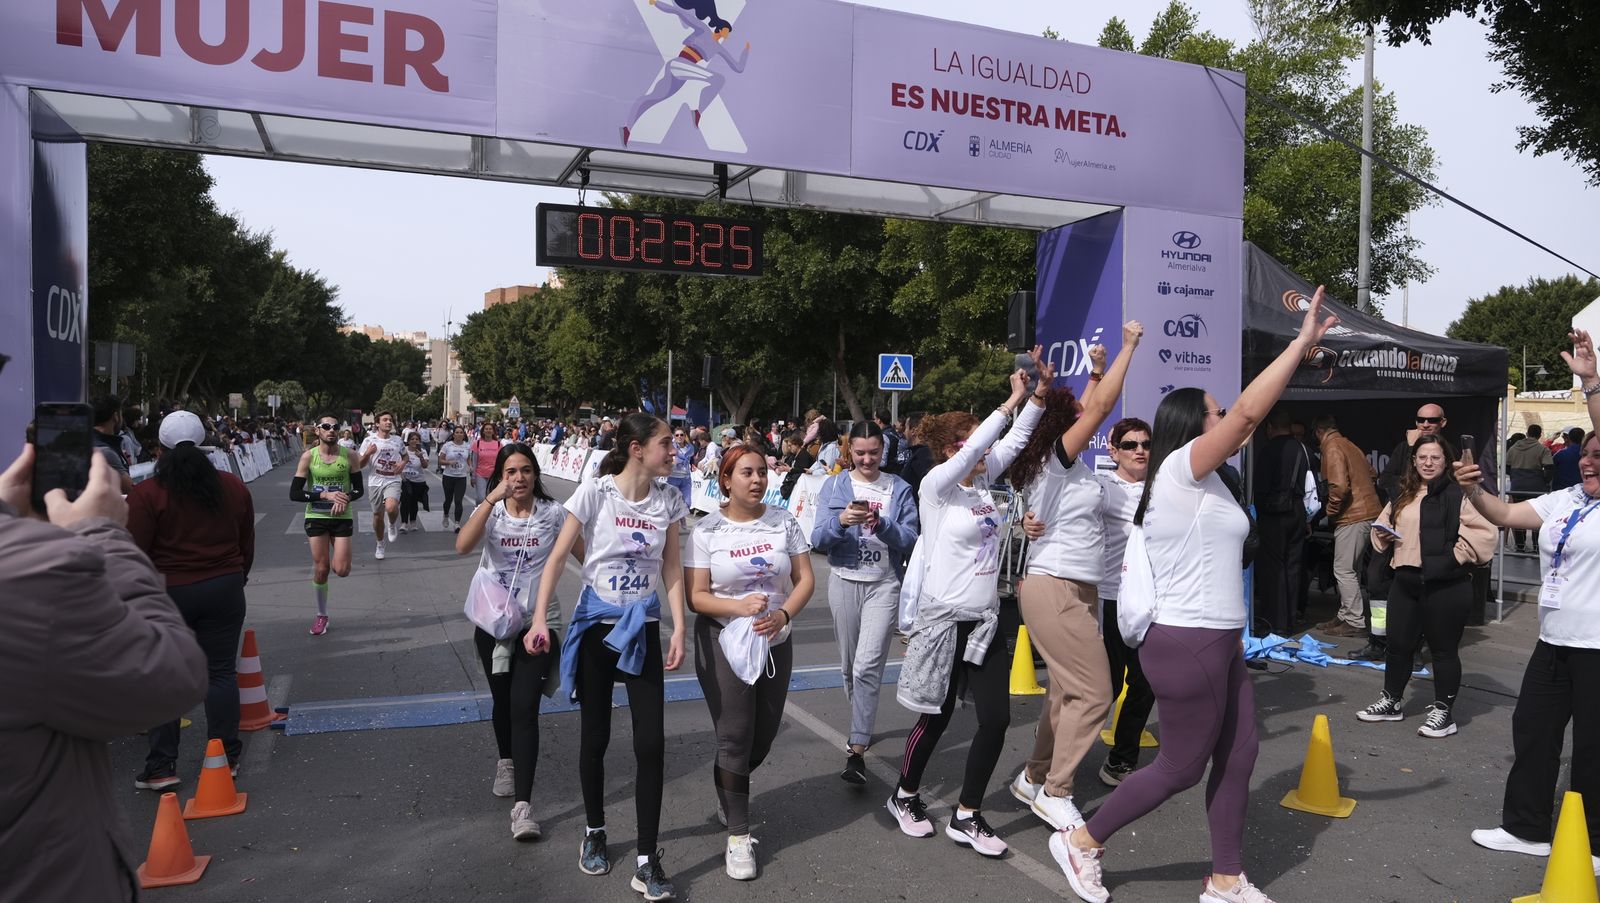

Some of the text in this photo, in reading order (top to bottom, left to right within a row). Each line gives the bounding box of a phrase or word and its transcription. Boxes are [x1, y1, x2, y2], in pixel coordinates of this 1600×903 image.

[56, 0, 450, 92] MUJER
[933, 47, 1092, 95] LA IGUALDAD
[891, 82, 1127, 138] ES NUESTRA META.
[903, 130, 945, 153] CDX
[989, 139, 1033, 155] ALMERÍA
[988, 151, 1012, 159] CIUDAD
[578, 213, 753, 270] 00:23:25
[1161, 250, 1212, 263] HYUNDAI
[1174, 284, 1215, 298] cajamar
[46, 285, 82, 344] CDX
[1163, 319, 1199, 338] CASI
[1048, 330, 1101, 377] CDX
[1175, 352, 1212, 365] vithas
[1088, 432, 1108, 449] RÍA
[729, 543, 774, 558] MUJER
[608, 574, 650, 591] 1244
